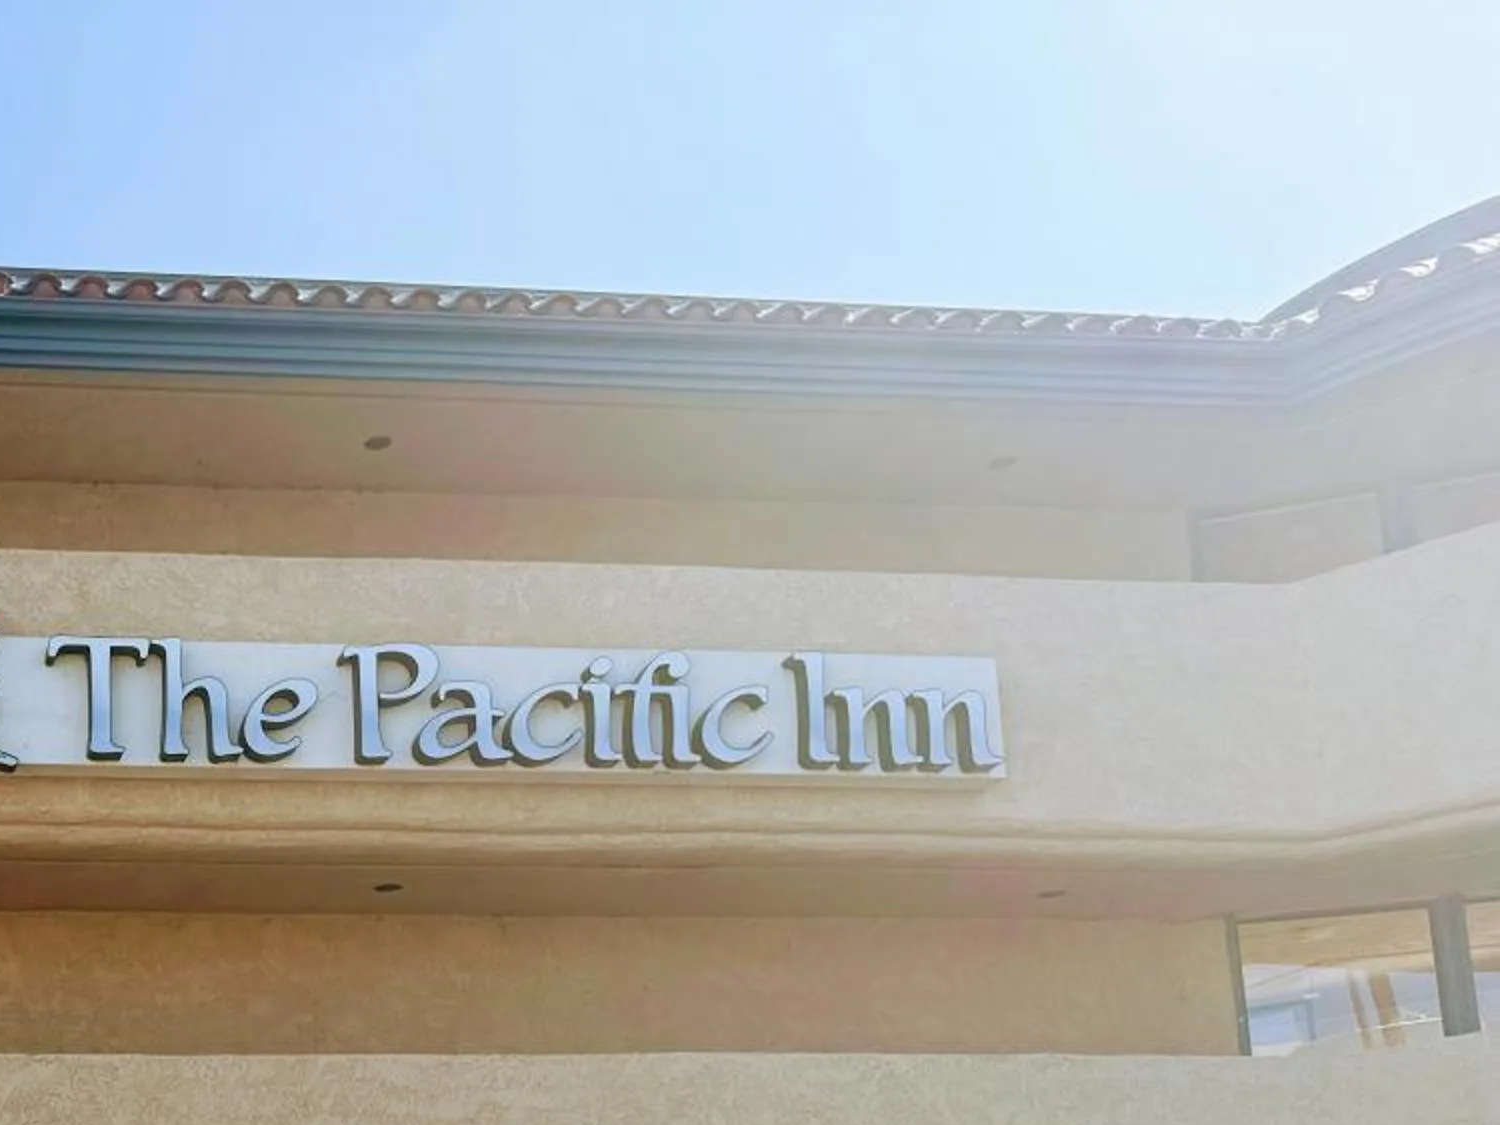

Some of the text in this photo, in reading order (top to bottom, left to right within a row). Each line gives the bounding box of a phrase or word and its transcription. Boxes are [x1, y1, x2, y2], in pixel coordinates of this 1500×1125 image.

[45, 635, 1005, 774] The Pacific Inn
